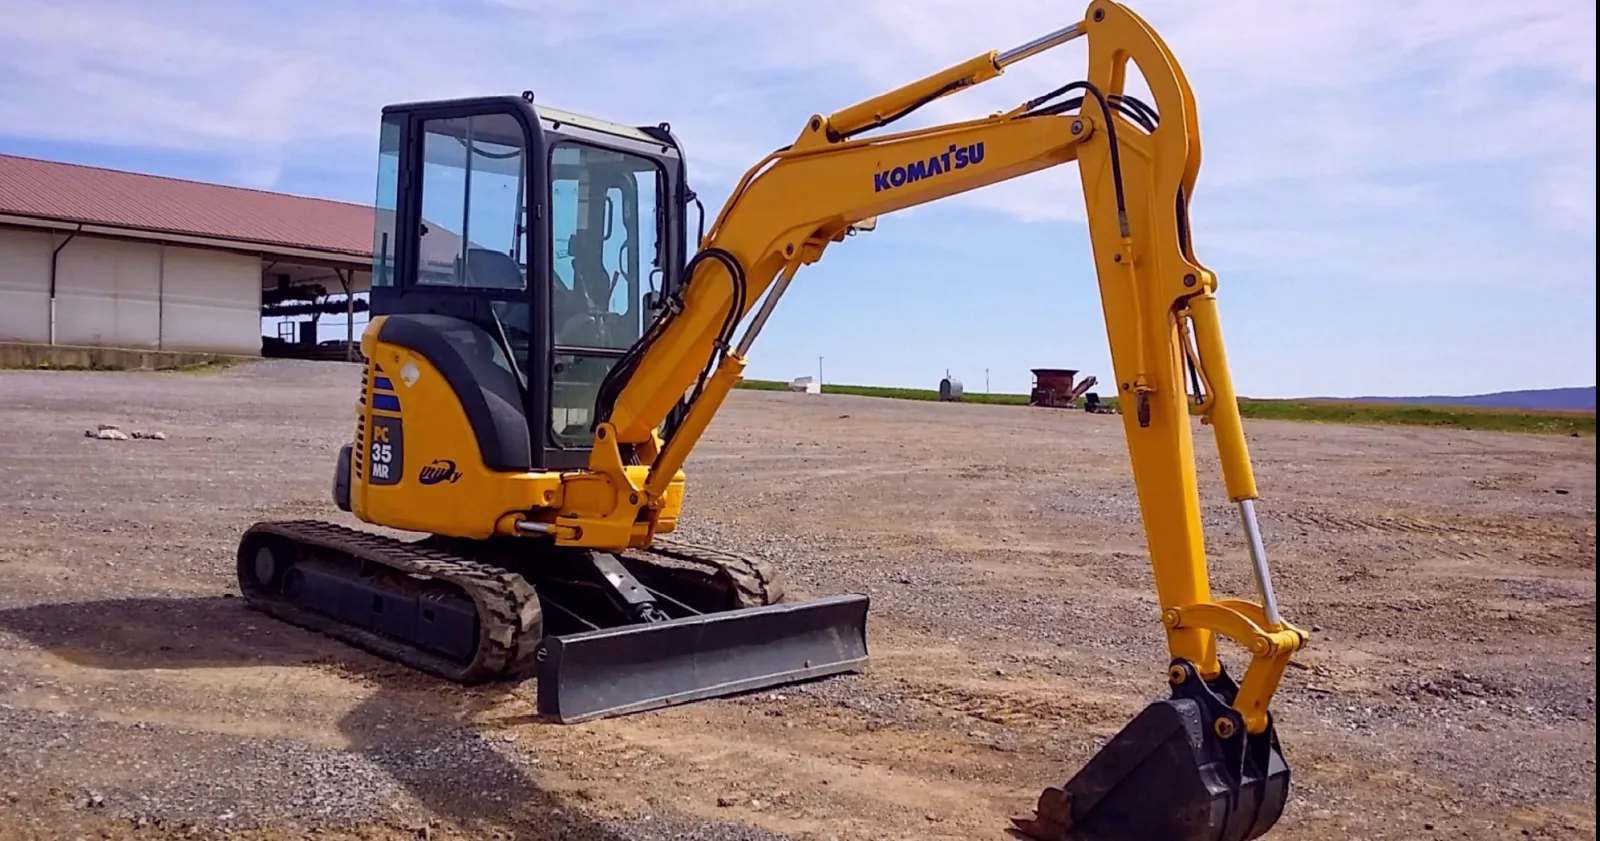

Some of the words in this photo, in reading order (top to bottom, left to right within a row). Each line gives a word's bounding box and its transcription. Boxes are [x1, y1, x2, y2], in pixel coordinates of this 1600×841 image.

[874, 142, 984, 193] KOMATSU
[374, 426, 389, 442] PC
[372, 443, 392, 463] 35
[372, 463, 389, 479] MR
